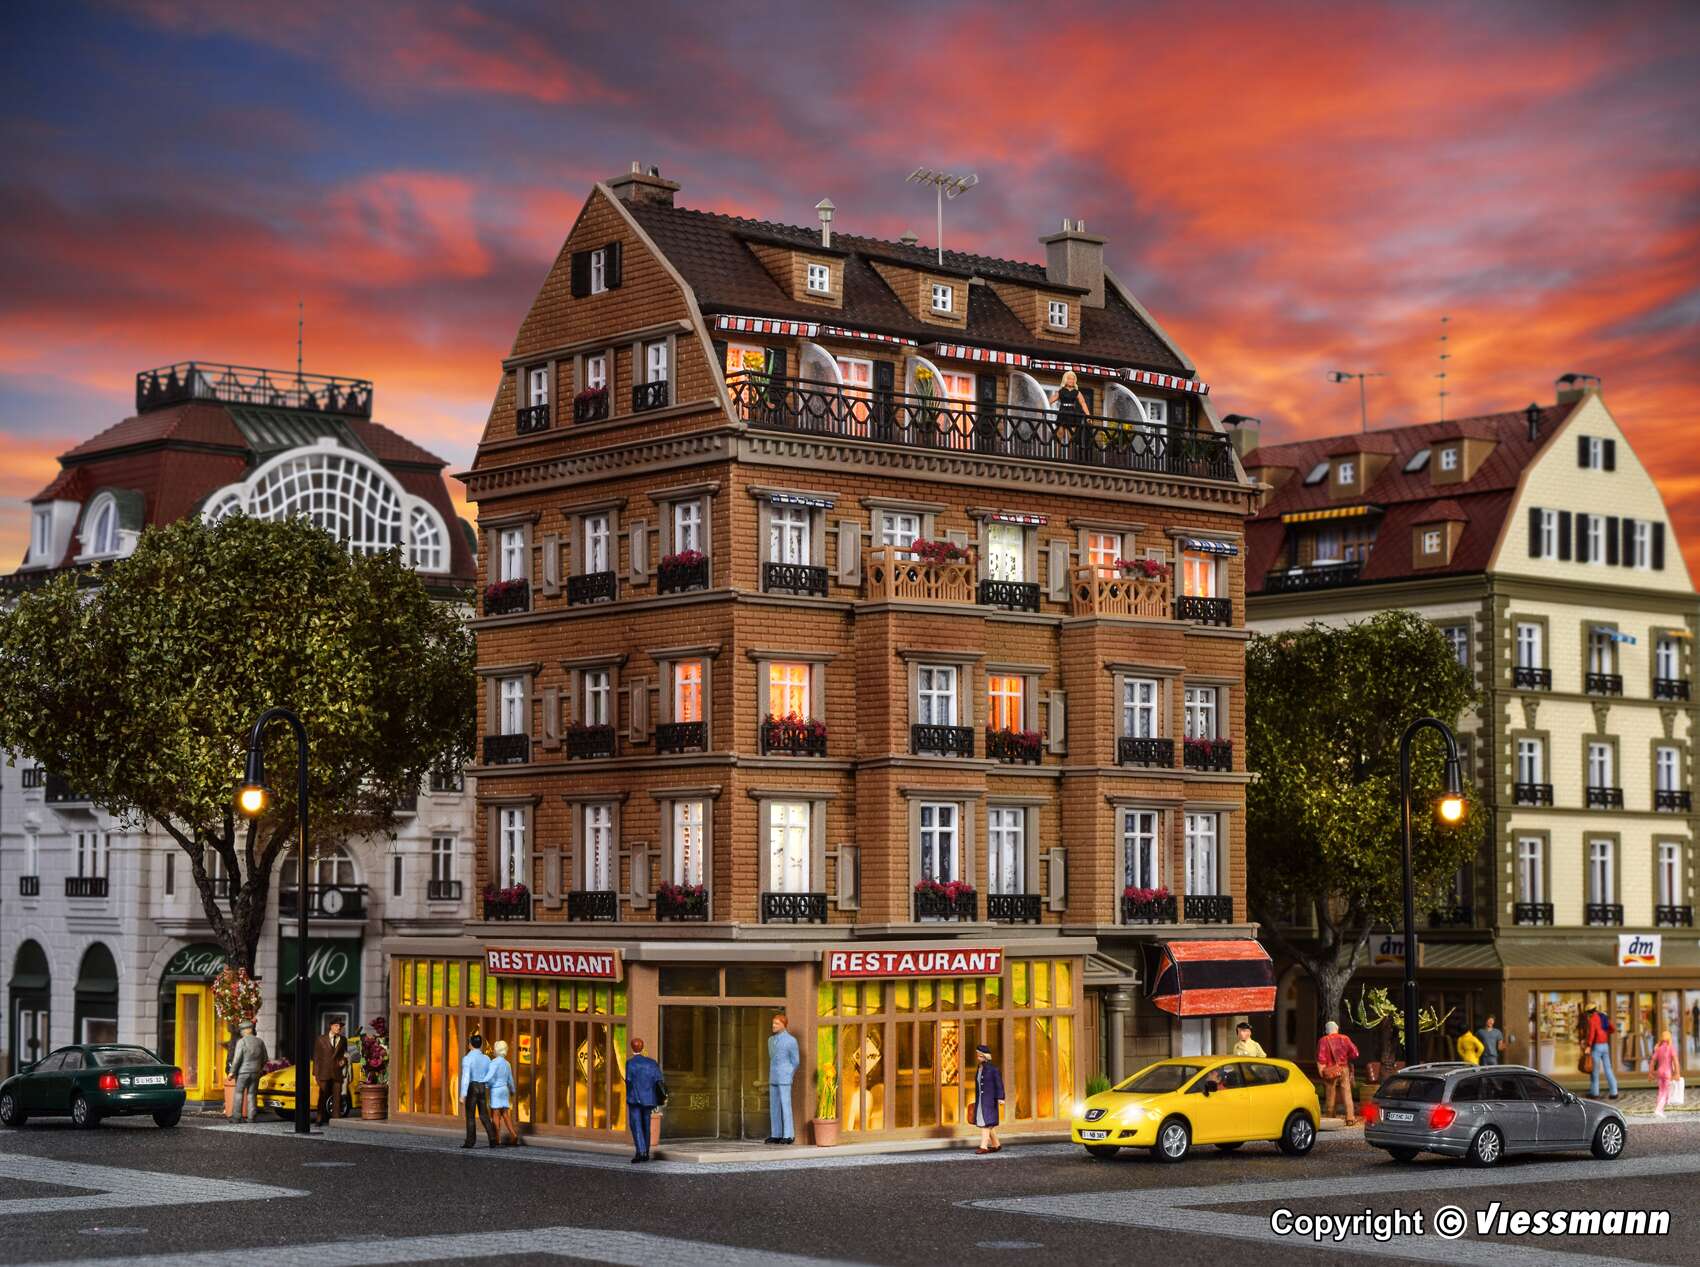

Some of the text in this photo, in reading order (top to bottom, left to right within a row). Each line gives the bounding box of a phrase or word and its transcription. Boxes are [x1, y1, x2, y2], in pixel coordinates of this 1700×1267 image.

[1628, 935, 1654, 955] dm
[488, 951, 613, 974] RESTAURANT
[831, 952, 1001, 972] RESTAURANT
